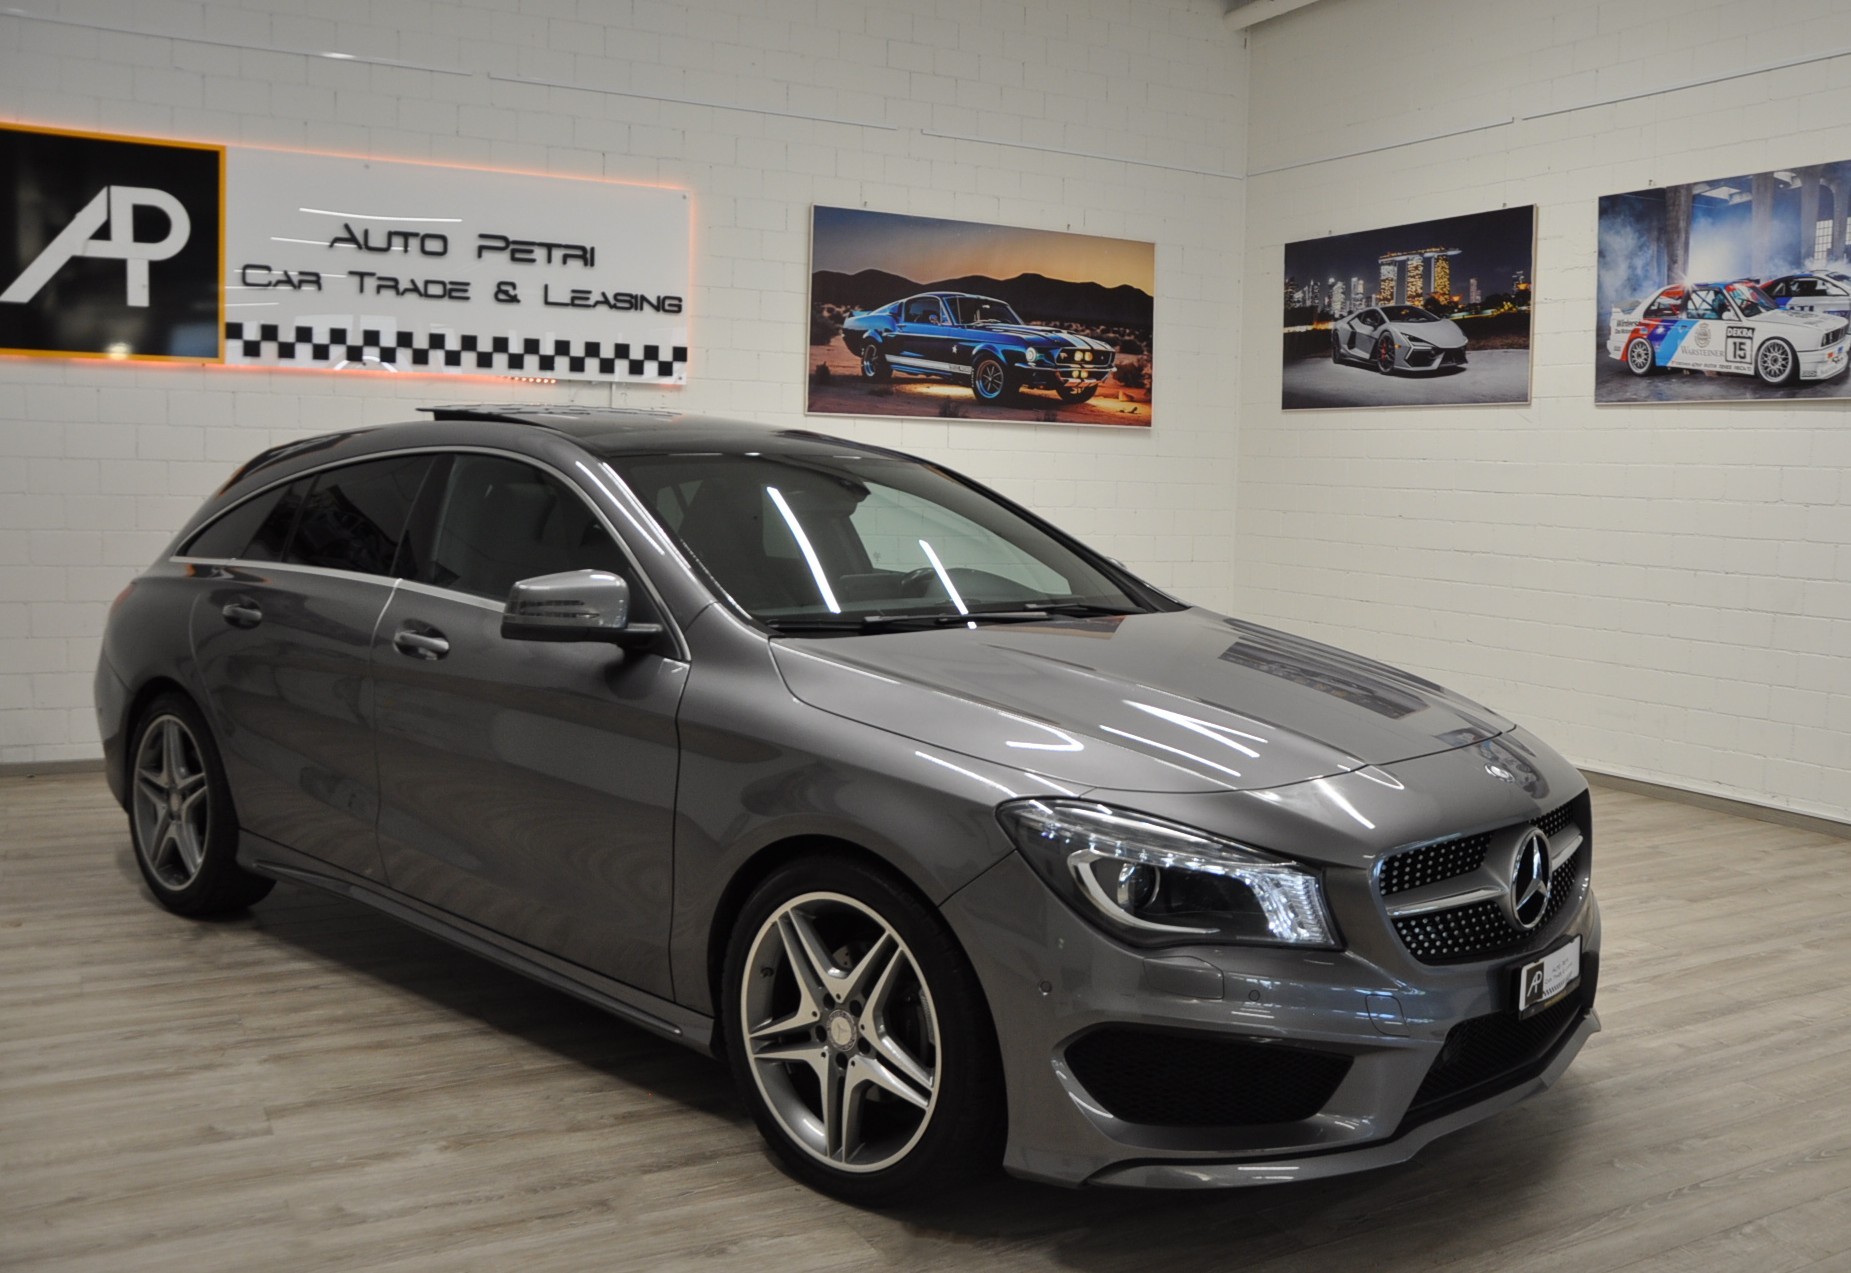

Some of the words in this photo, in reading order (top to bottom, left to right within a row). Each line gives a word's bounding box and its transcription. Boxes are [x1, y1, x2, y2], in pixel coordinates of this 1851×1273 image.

[0, 185, 191, 307] AP
[329, 222, 449, 256] AUTO
[477, 233, 595, 268] PETRI
[241, 263, 323, 291] CAR
[348, 270, 471, 300] TRADE
[494, 281, 521, 303] &
[544, 283, 683, 314] LEASING
[1727, 327, 1753, 337] DEKRA
[1733, 341, 1747, 360] 15
